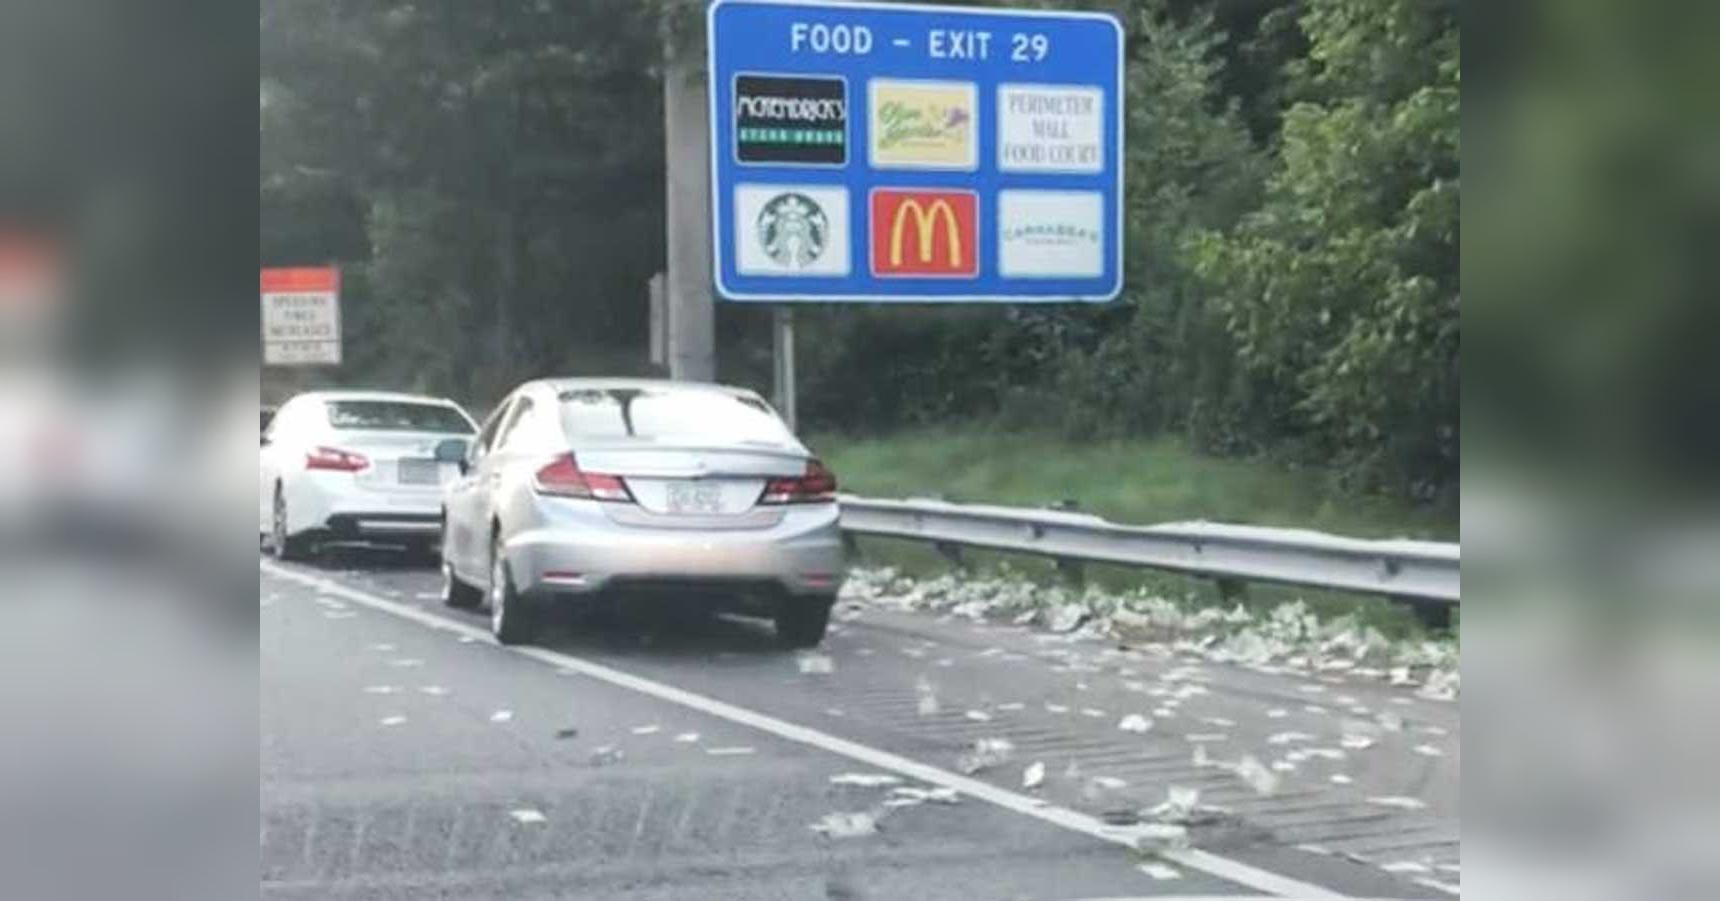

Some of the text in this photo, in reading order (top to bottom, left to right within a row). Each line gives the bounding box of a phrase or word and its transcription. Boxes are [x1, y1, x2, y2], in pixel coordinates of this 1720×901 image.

[790, 23, 1050, 62] FOOD - EXIT 29
[1007, 93, 1095, 115] PERIMETER
[1031, 117, 1070, 138] MALL
[1003, 143, 1098, 164] FOOD COURT
